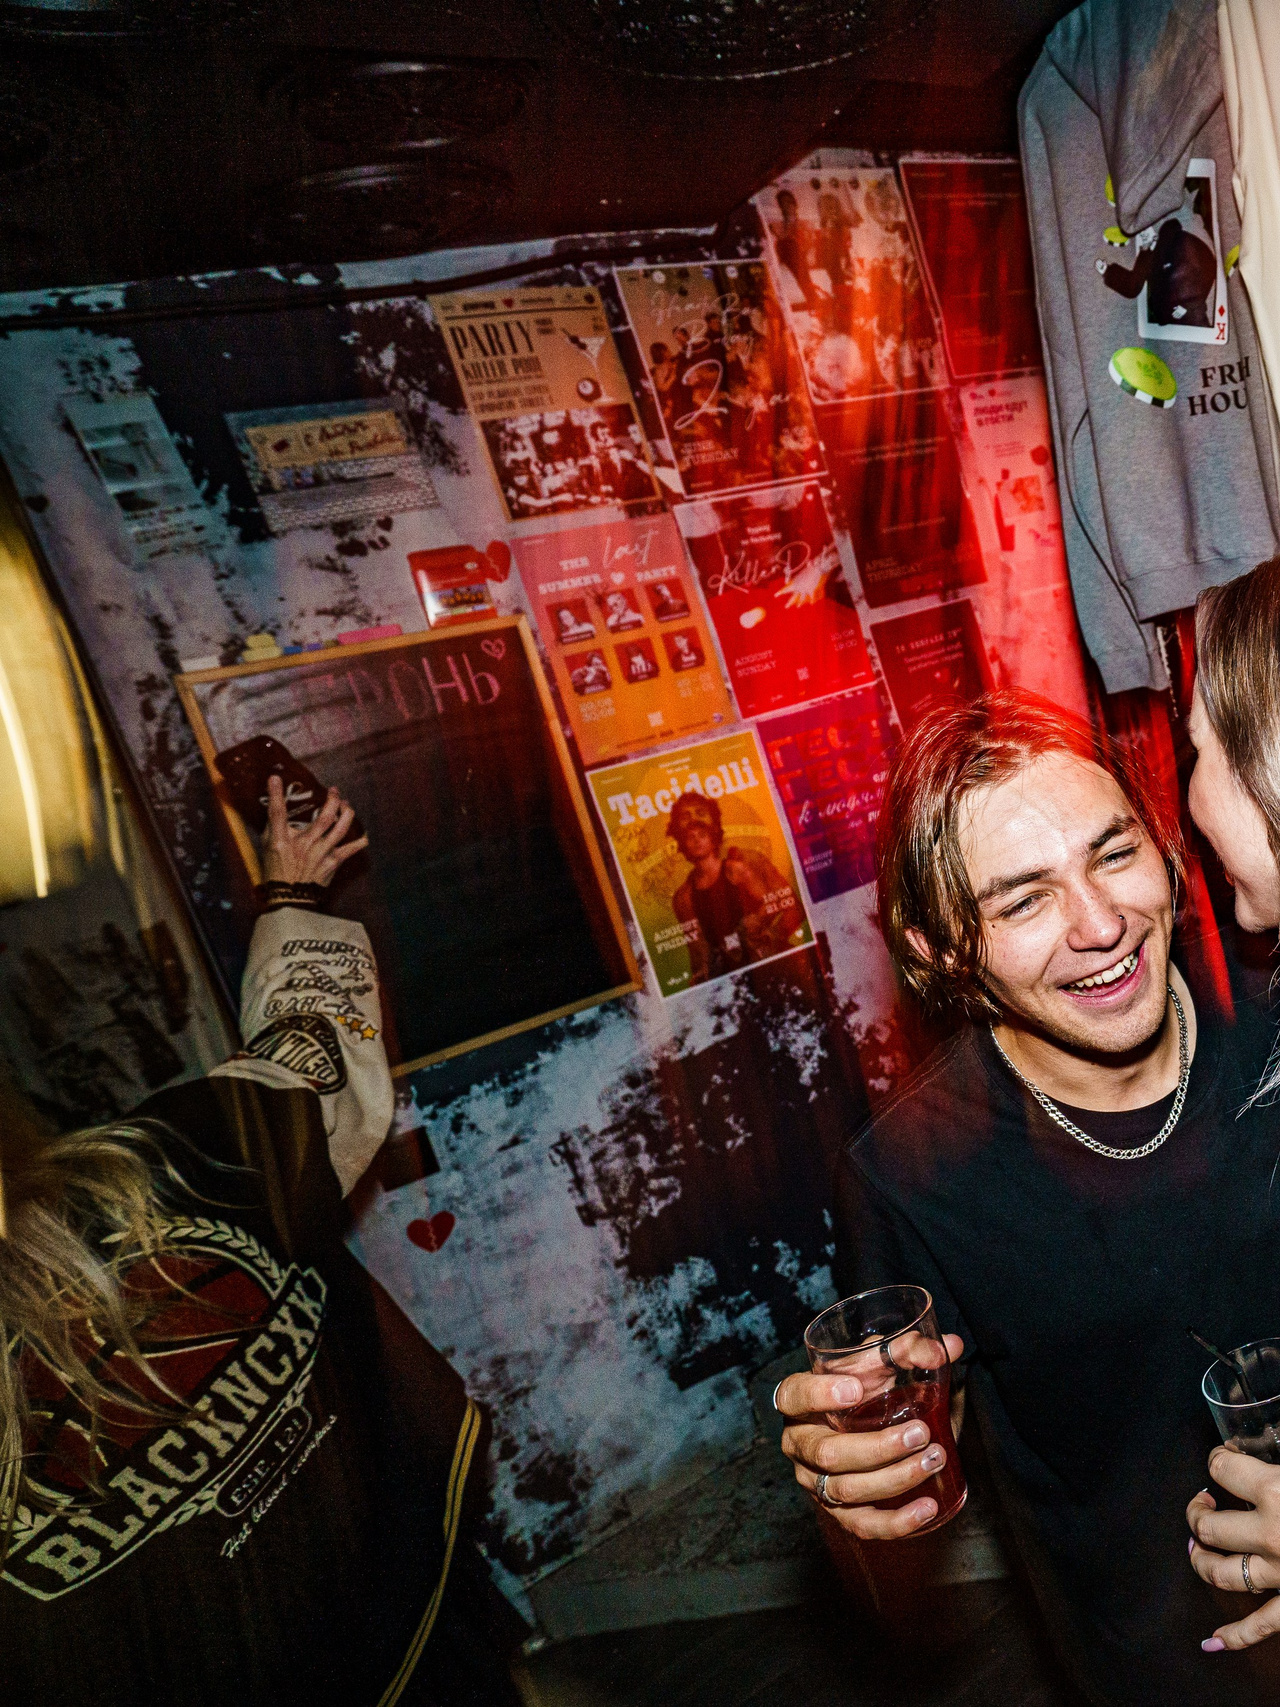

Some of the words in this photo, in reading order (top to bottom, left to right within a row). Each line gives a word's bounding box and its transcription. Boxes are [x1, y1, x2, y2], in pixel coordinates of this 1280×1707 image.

[450, 320, 534, 360] PARTY
[559, 556, 590, 571] THE
[538, 573, 603, 595] SUMMER
[636, 565, 676, 583] PARTY
[736, 660, 776, 677] SUNDAY
[607, 757, 759, 826] Tacidelli
[653, 918, 699, 943] AUGUST
[655, 929, 699, 954] FRIDAY
